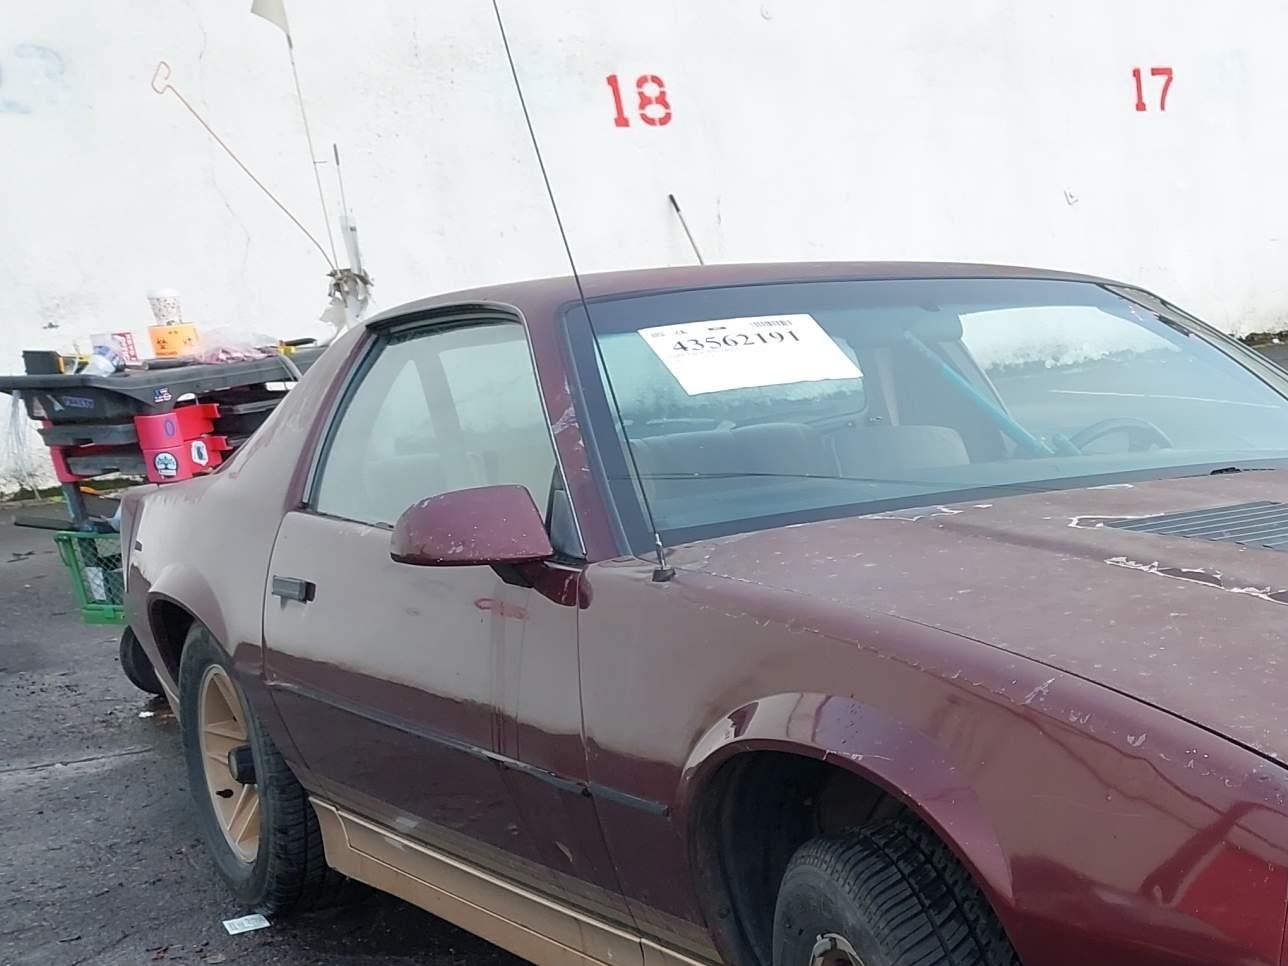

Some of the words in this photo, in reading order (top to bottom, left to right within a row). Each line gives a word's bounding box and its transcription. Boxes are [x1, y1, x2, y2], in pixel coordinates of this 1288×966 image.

[606, 73, 673, 128] 18
[1132, 66, 1174, 112] 17
[672, 329, 801, 353] 43562191
